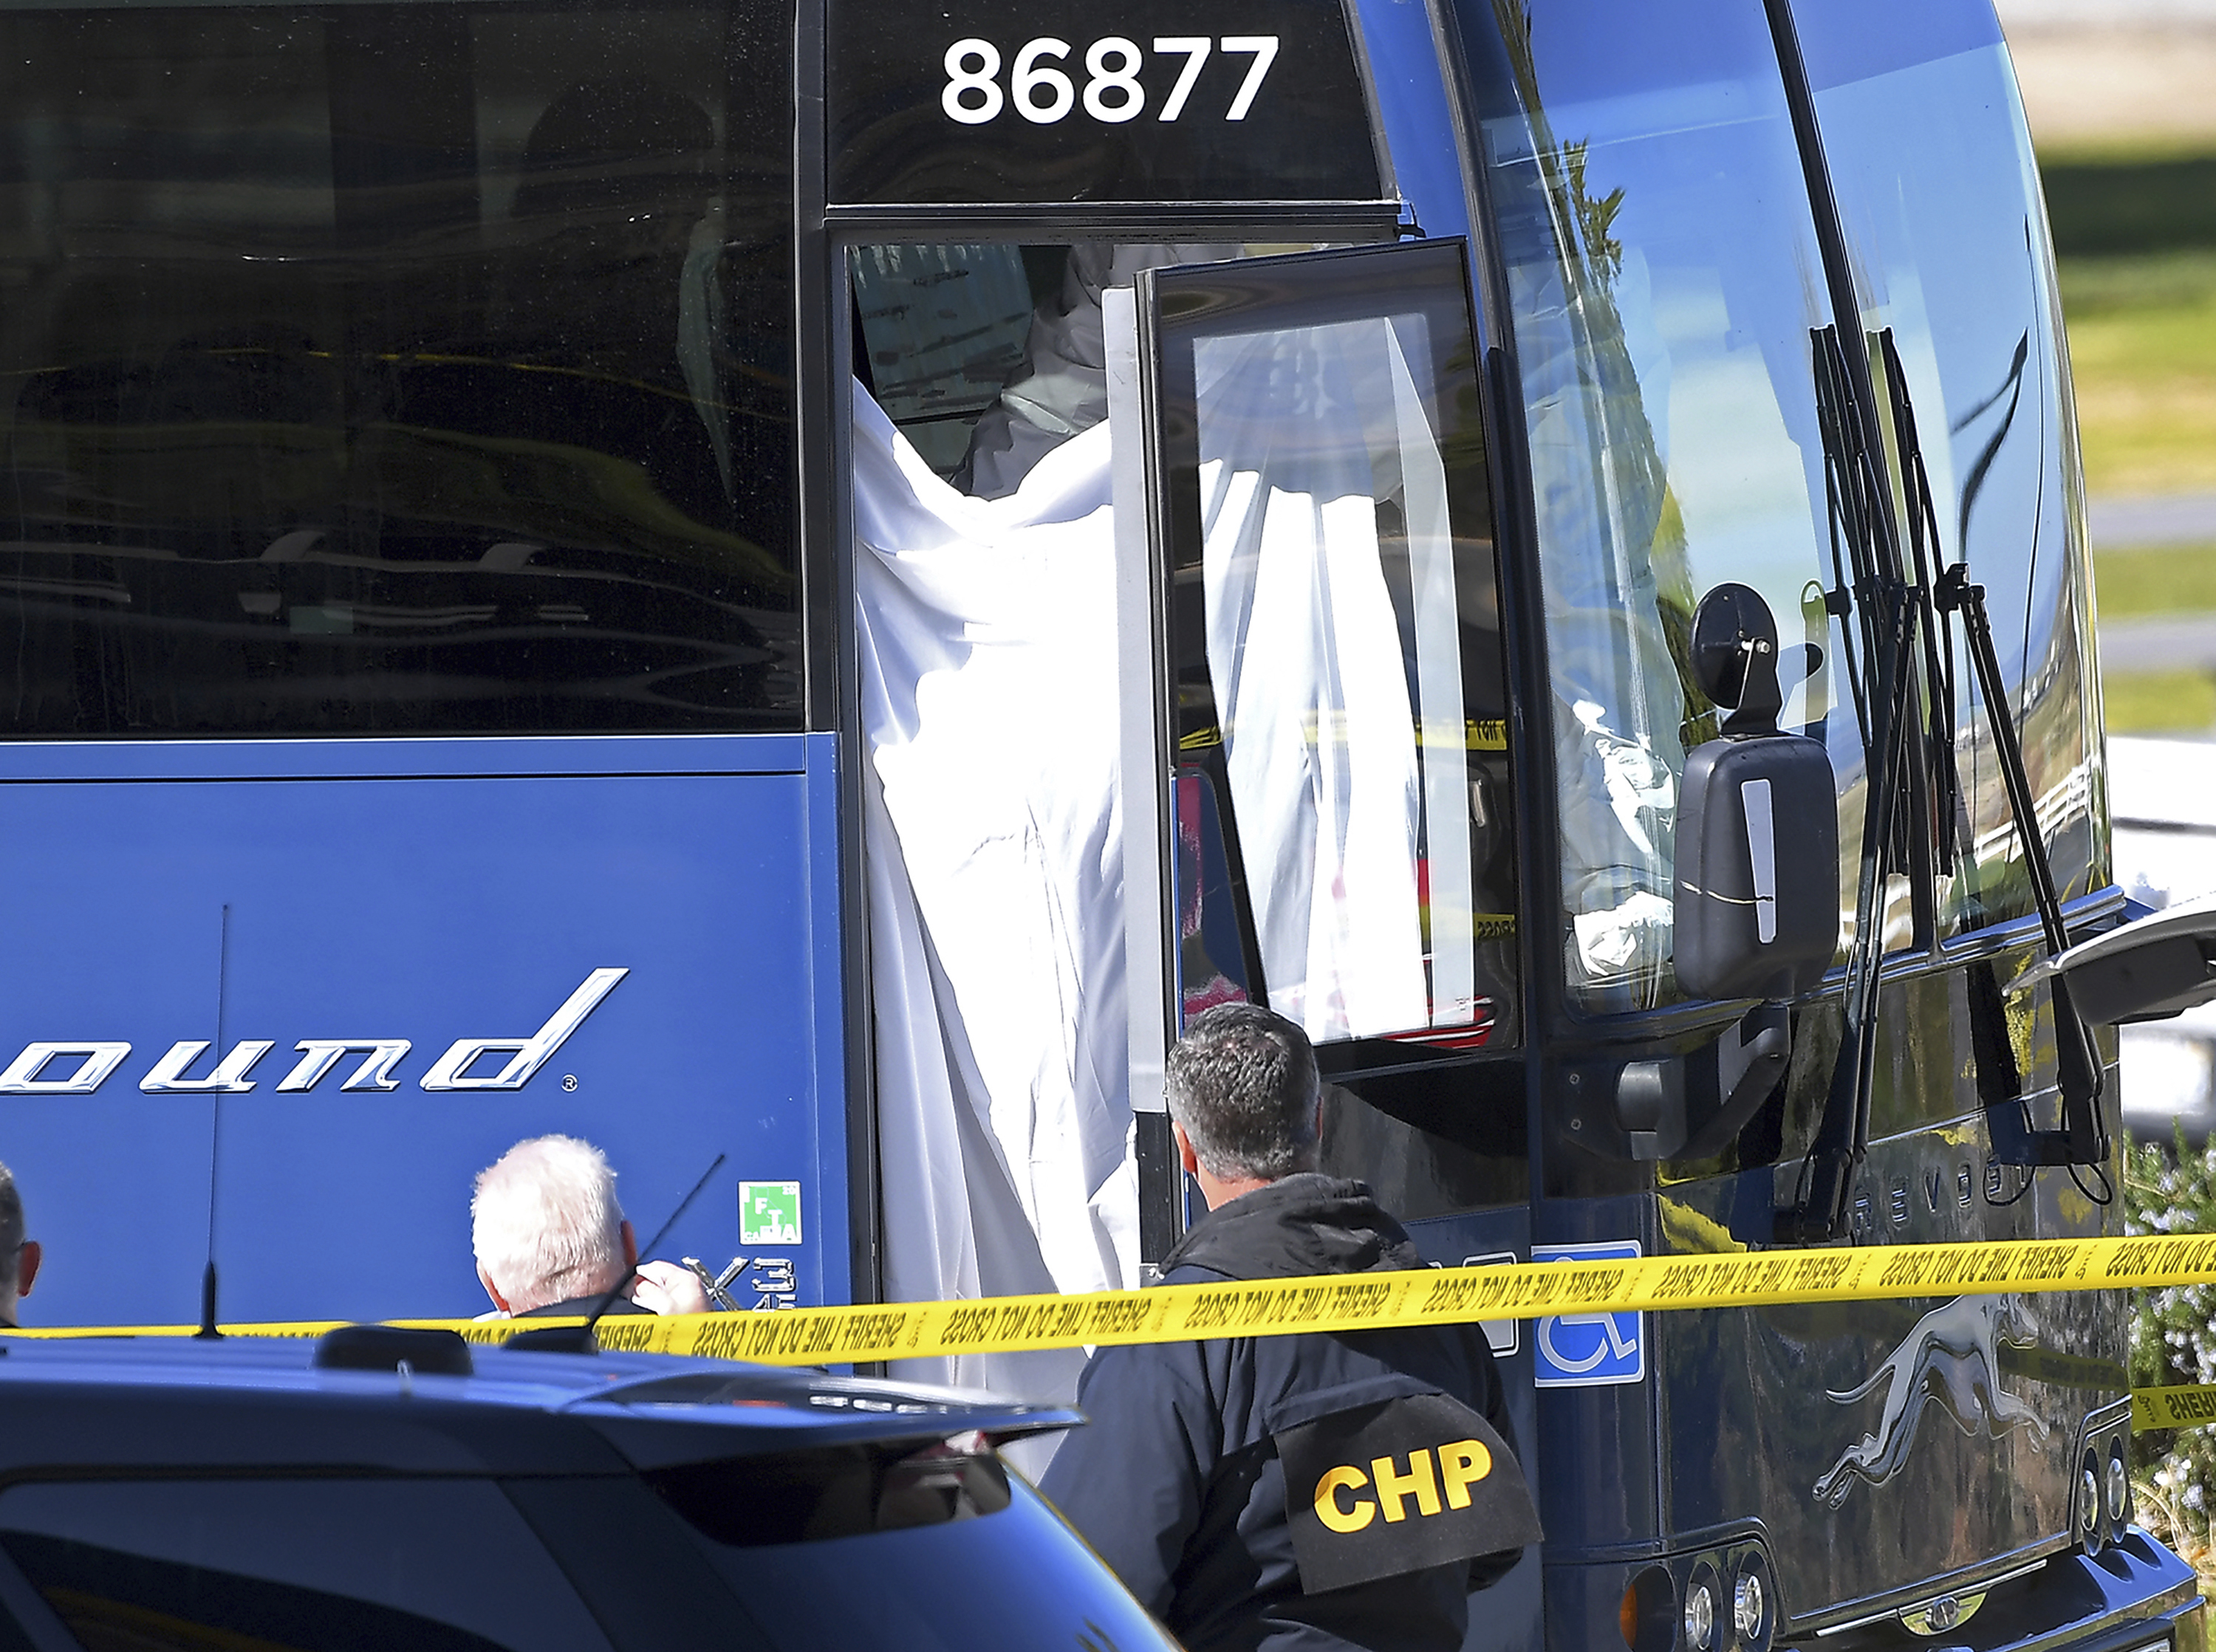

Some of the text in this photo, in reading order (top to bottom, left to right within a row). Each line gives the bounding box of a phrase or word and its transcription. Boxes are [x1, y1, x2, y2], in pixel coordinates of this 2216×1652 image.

[940, 35, 1280, 124] 86877
[0, 967, 630, 1094] ound
[1314, 1439, 1492, 1533] CHP
